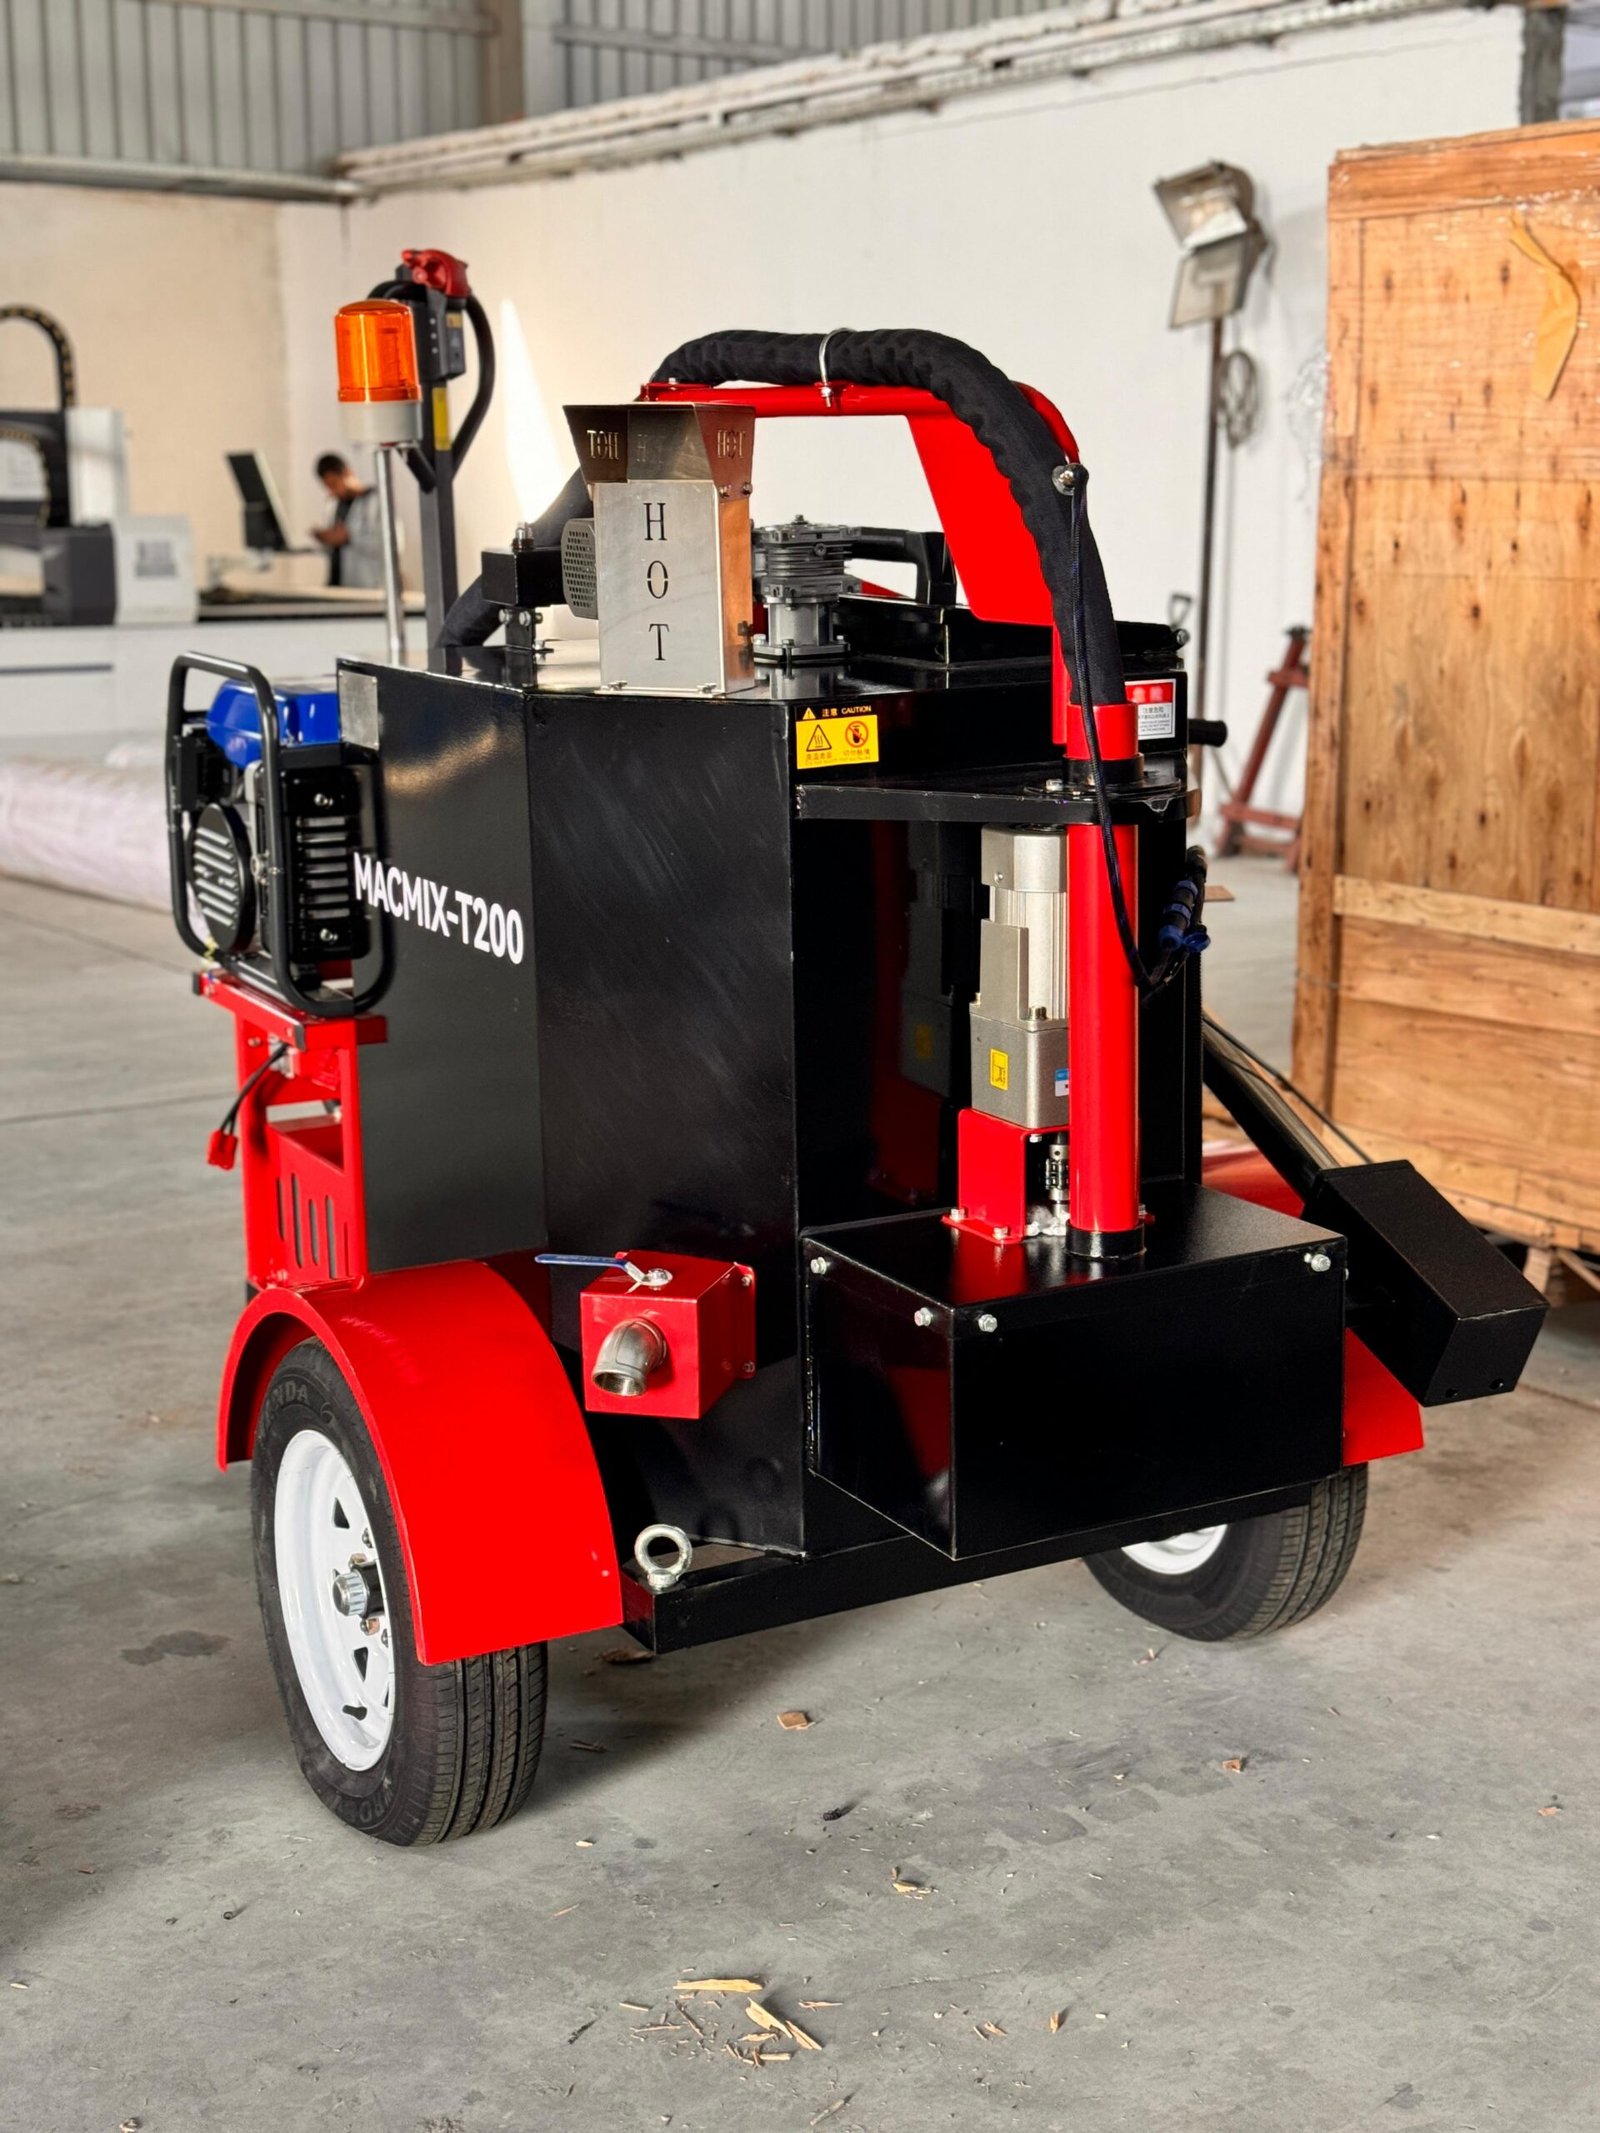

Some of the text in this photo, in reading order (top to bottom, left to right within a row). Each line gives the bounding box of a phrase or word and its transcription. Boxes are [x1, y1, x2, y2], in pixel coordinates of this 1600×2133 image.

[716, 430, 747, 460] HOT
[642, 501, 670, 661] HOT
[840, 704, 872, 715] CAUTION
[353, 851, 525, 965] MACMIX-T200
